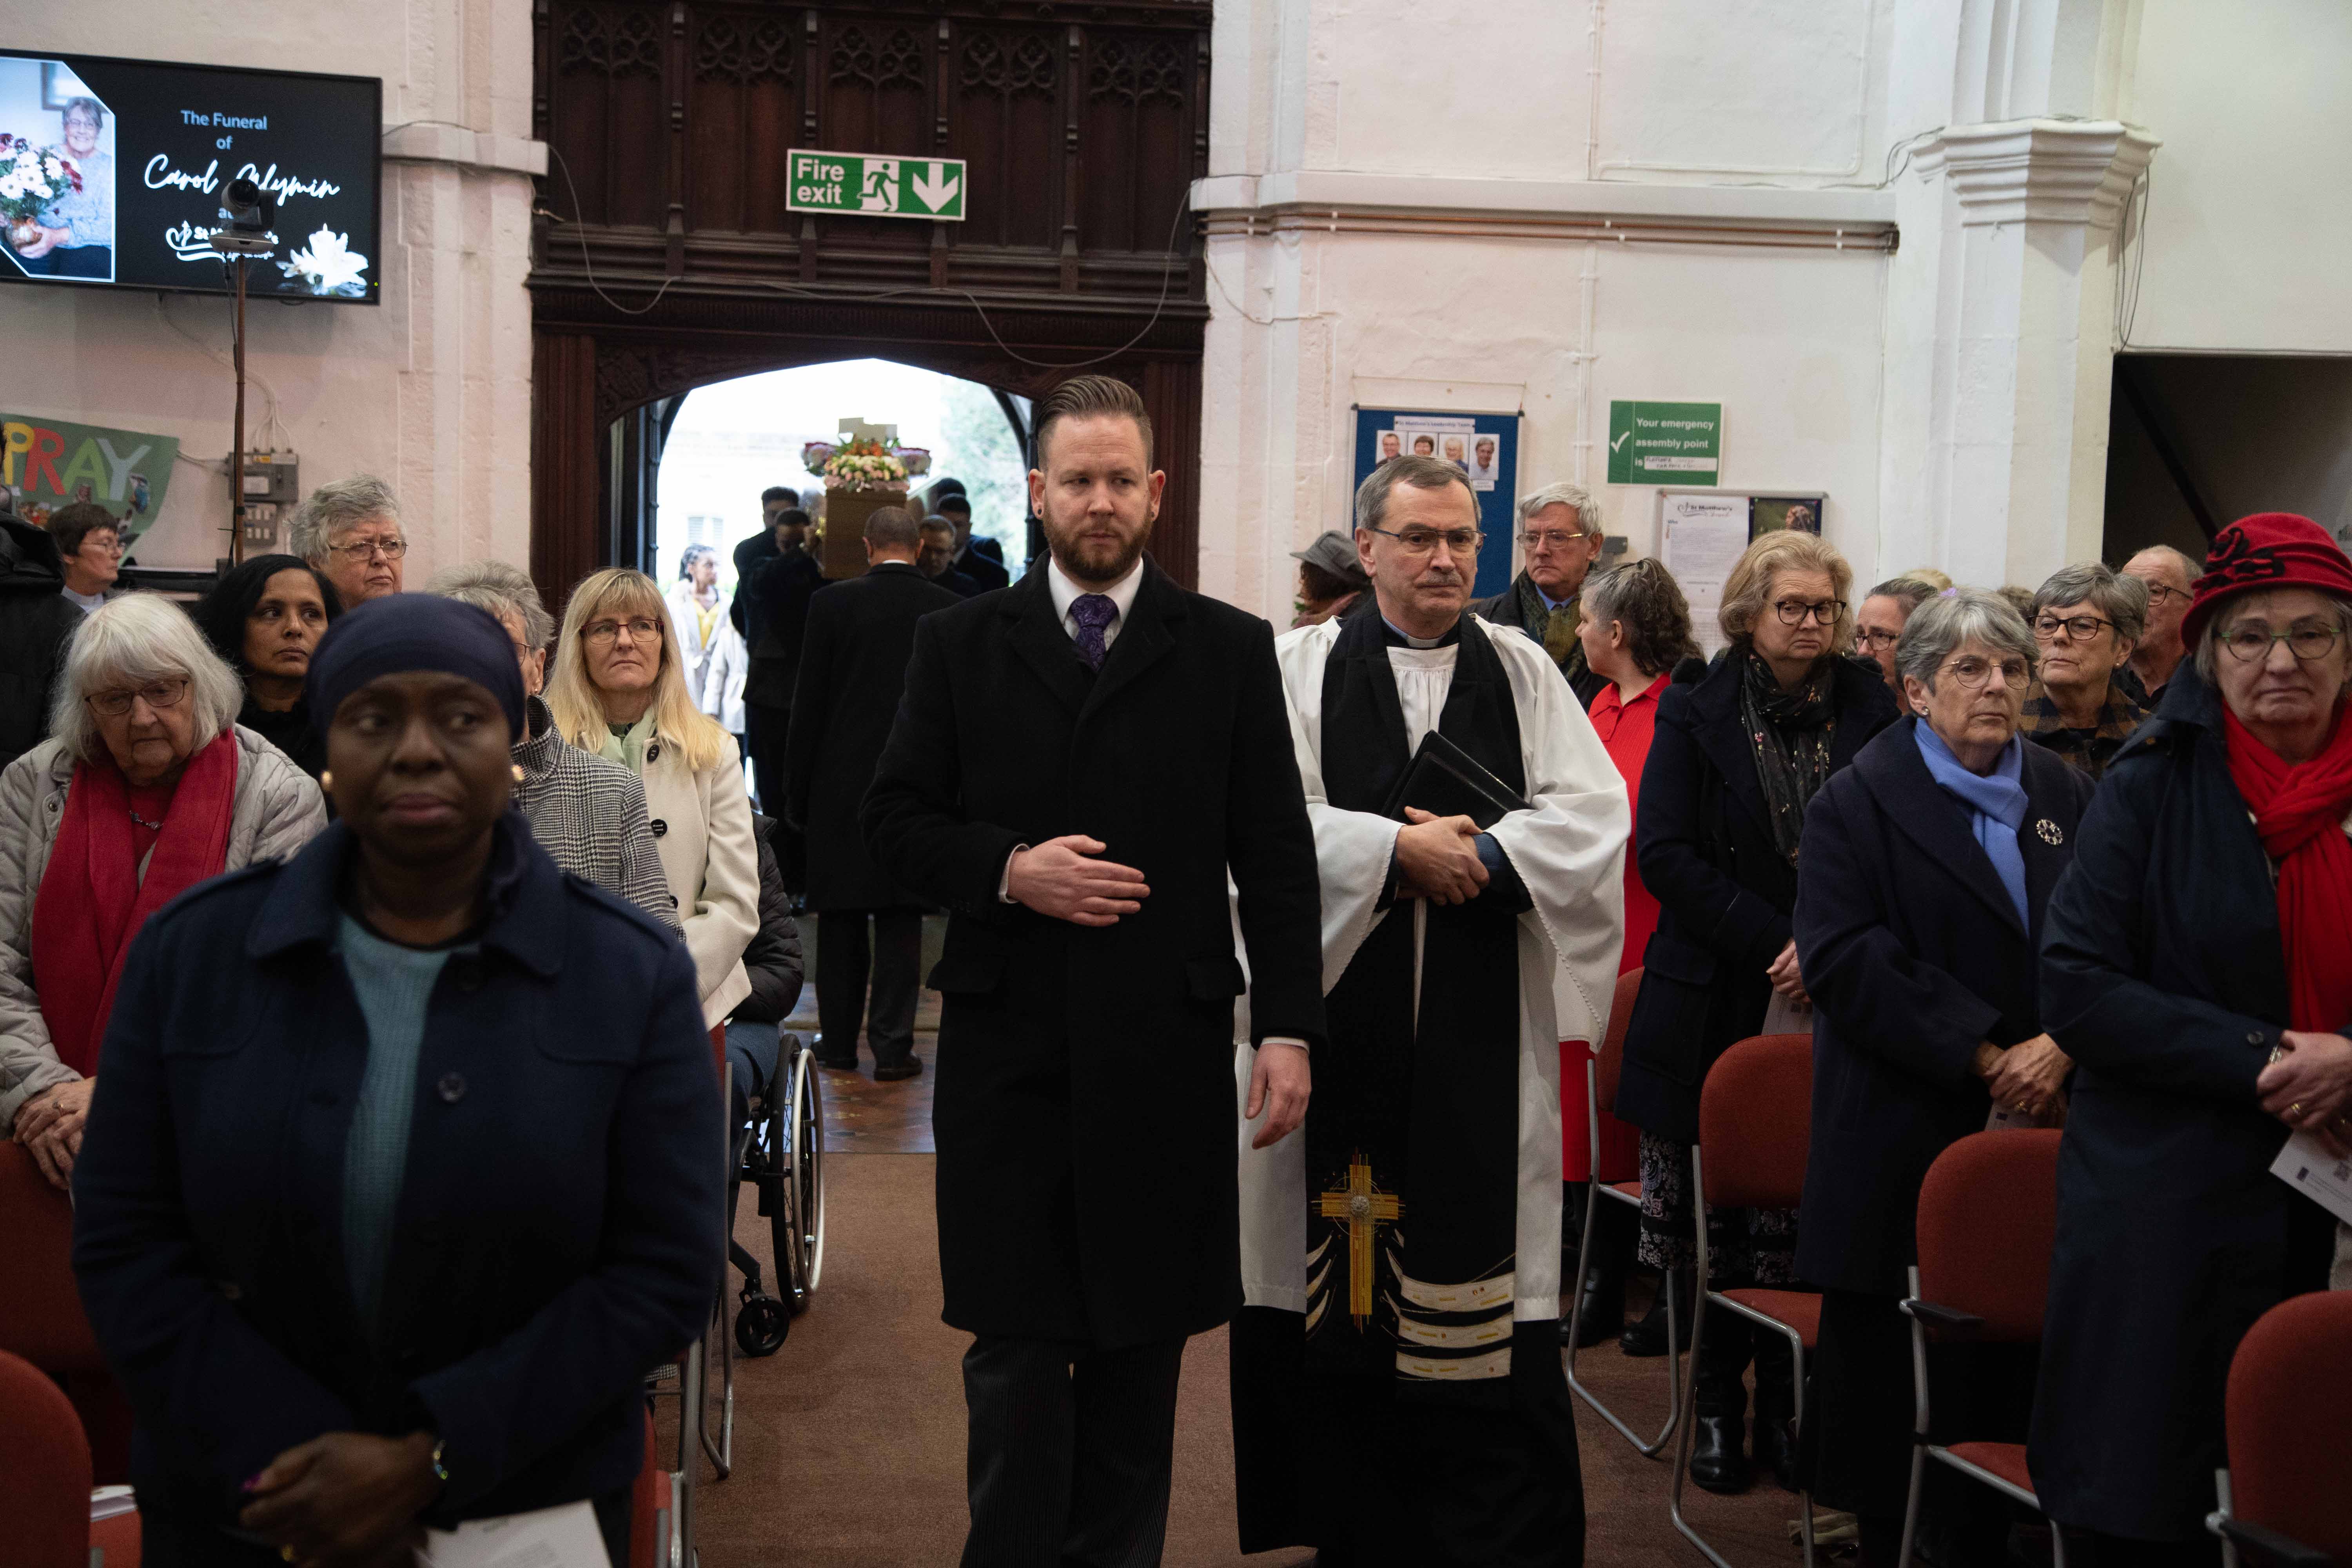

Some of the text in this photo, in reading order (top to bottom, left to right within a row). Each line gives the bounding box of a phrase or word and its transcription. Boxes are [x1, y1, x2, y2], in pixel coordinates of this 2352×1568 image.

[181, 110, 267, 130] The Funeral
[216, 135, 233, 150] of
[144, 154, 219, 194] Carol
[797, 158, 845, 182] Fire
[797, 183, 842, 204] exit
[1637, 417, 1714, 431] Your emergency
[1636, 439, 1709, 450] assembly point
[3, 422, 152, 502] PRAY
